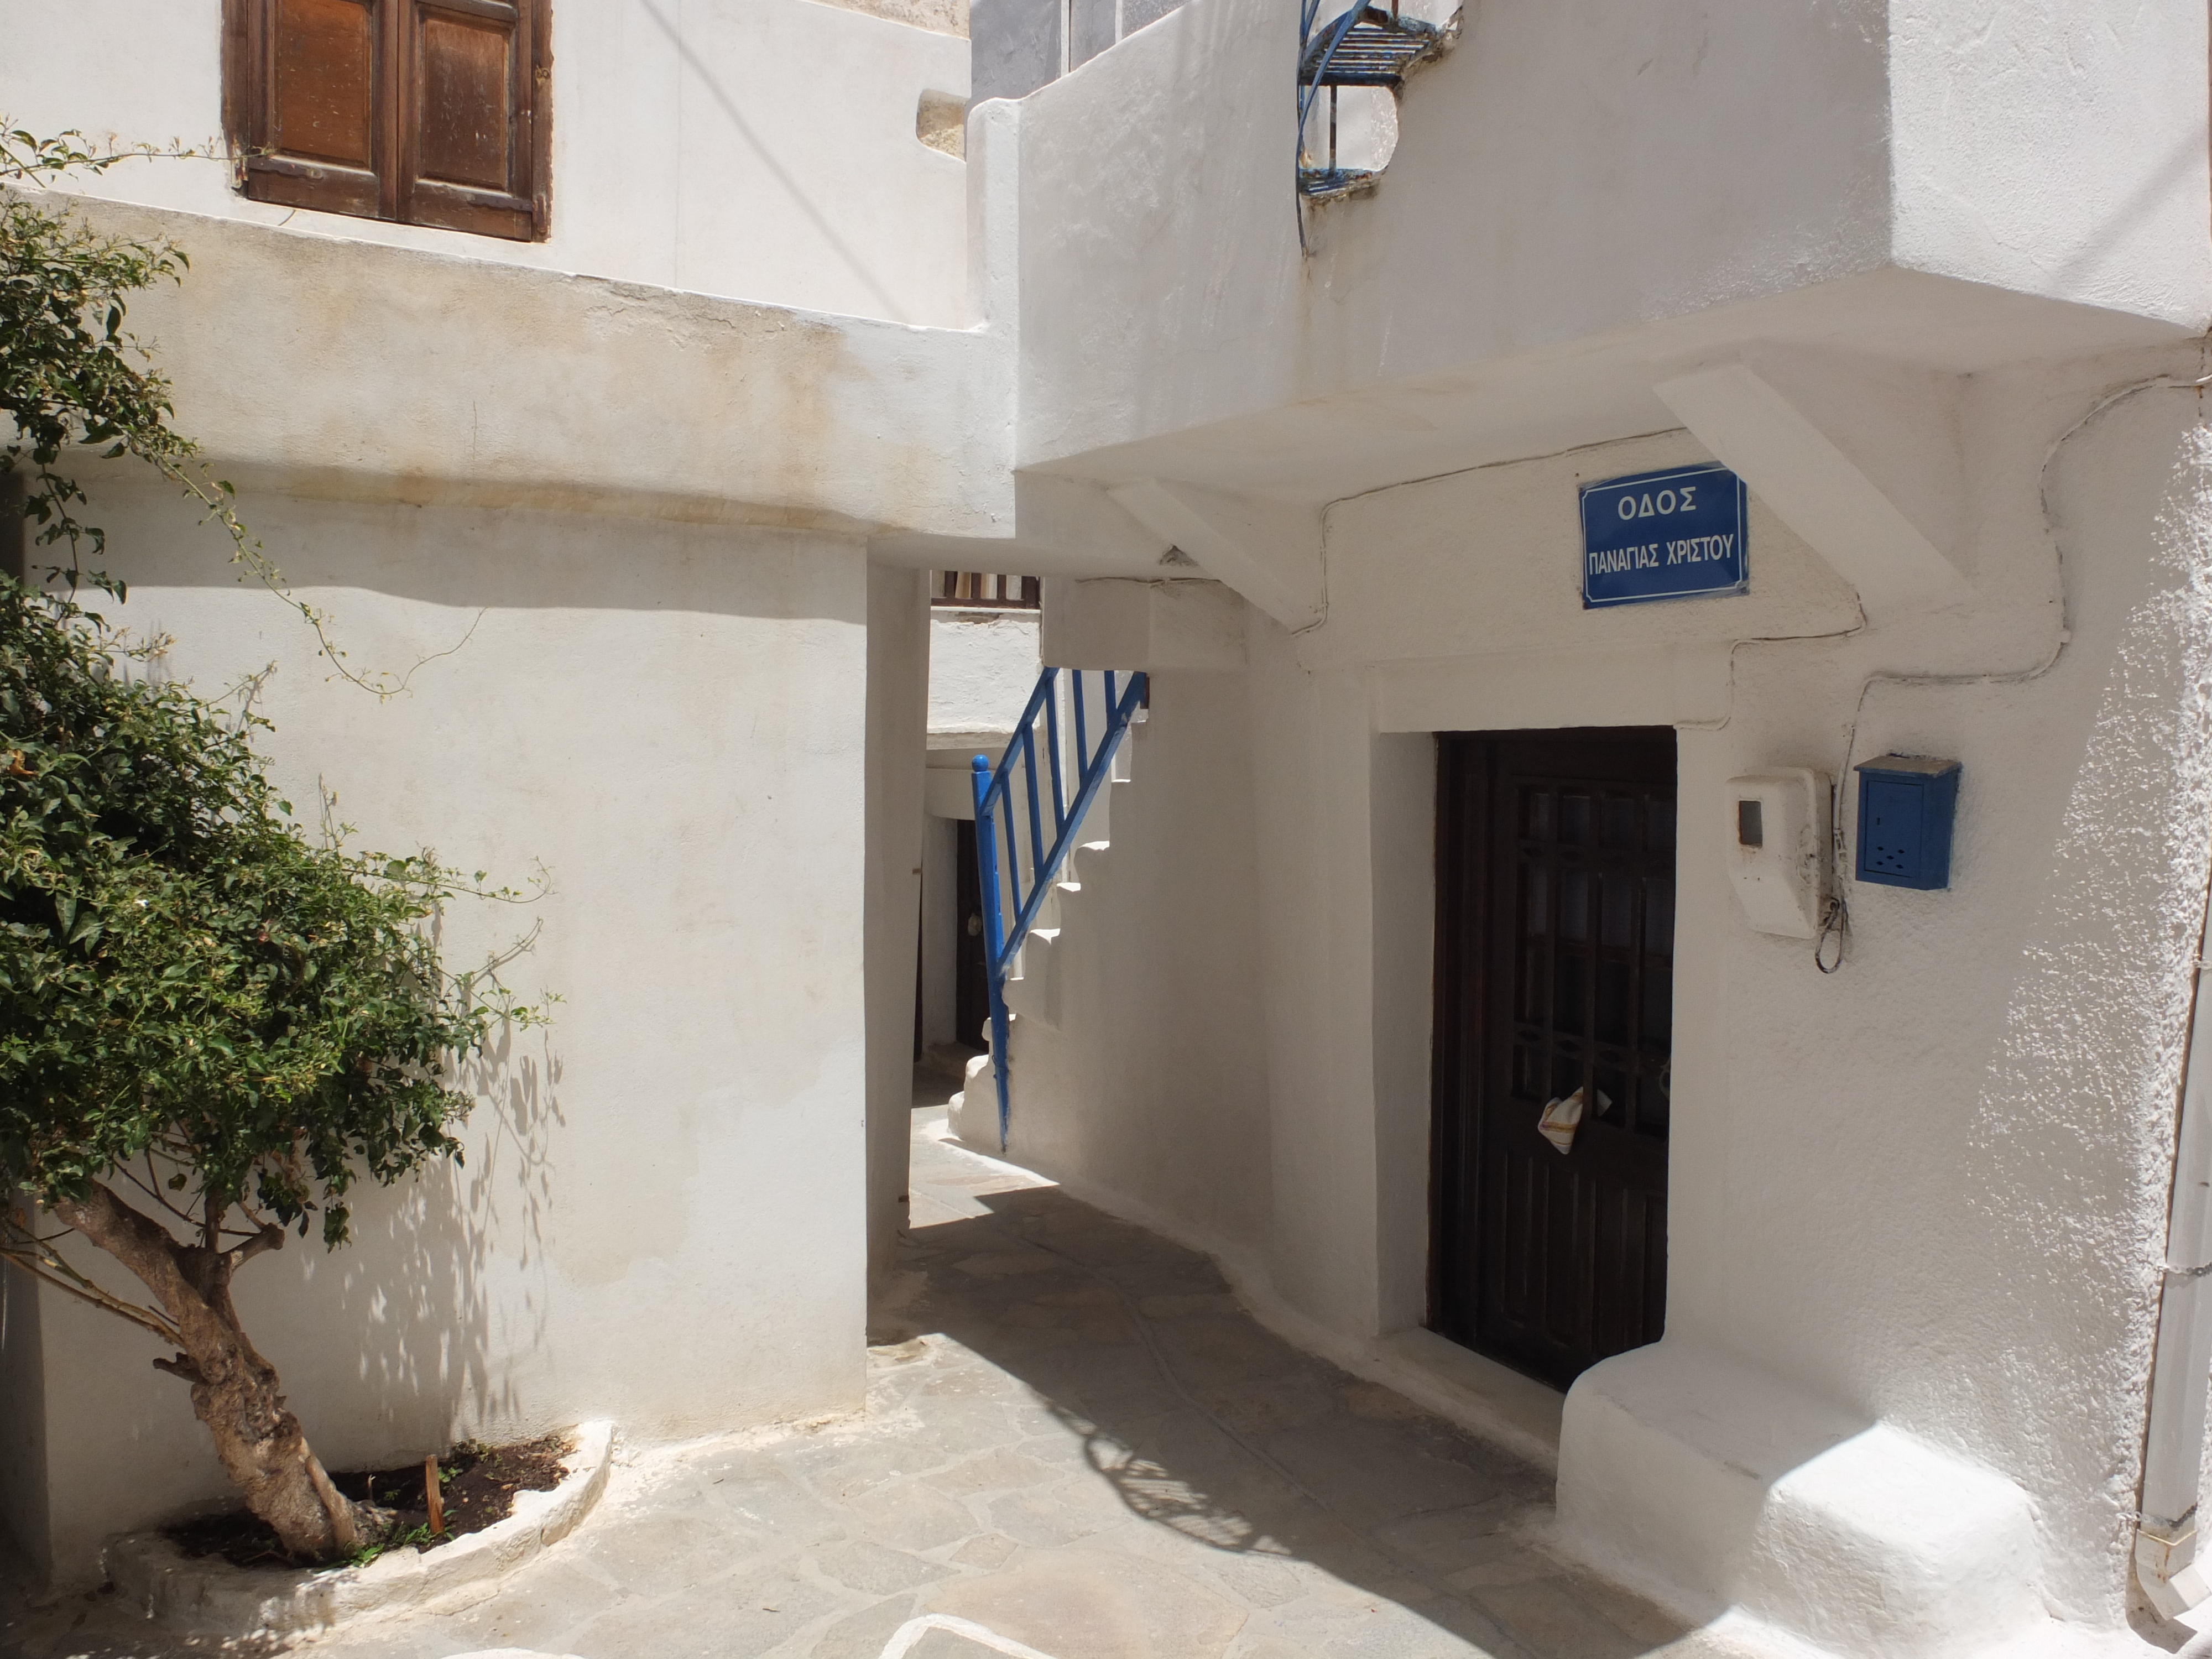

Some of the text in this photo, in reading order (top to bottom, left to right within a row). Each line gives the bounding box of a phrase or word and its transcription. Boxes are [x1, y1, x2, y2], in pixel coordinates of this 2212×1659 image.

[1618, 486, 1697, 520] ΟΔΟΣ
[1589, 534, 1734, 575] ΠΑΝΑΓΙΑΣ ΧΡΙΣΤΟΥ
